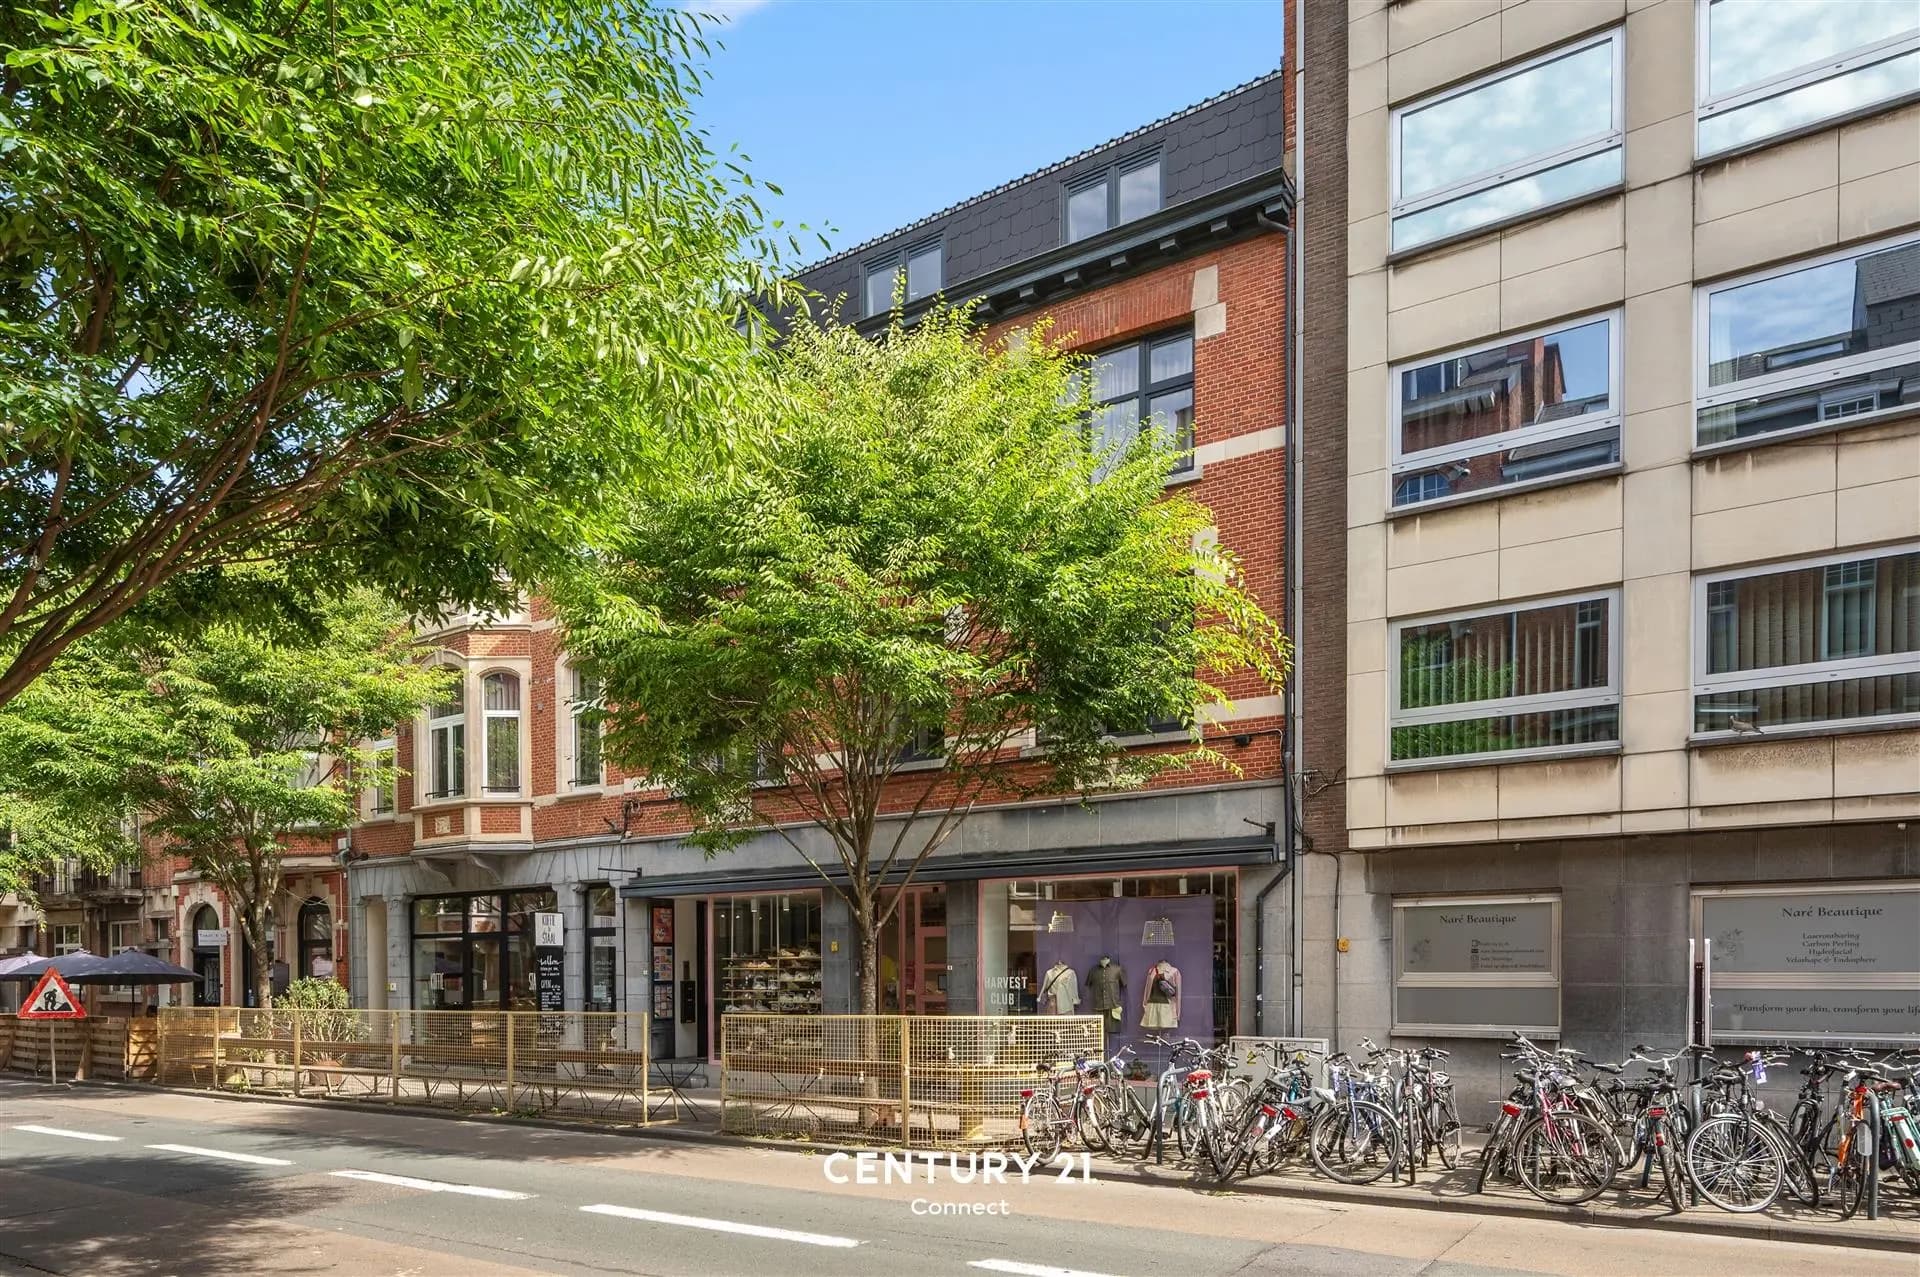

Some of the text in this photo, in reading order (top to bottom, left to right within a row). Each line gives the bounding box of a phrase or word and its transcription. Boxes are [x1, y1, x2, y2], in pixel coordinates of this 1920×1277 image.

[1781, 906, 1884, 919] Naré Beautique
[1440, 914, 1517, 925] Naré Beautique
[985, 976, 1028, 989] HARVEST
[990, 993, 1015, 1005] CLUB
[1785, 1006, 1806, 1015] your
[1833, 1003, 1880, 1015] transform
[1882, 1007, 1905, 1016] your
